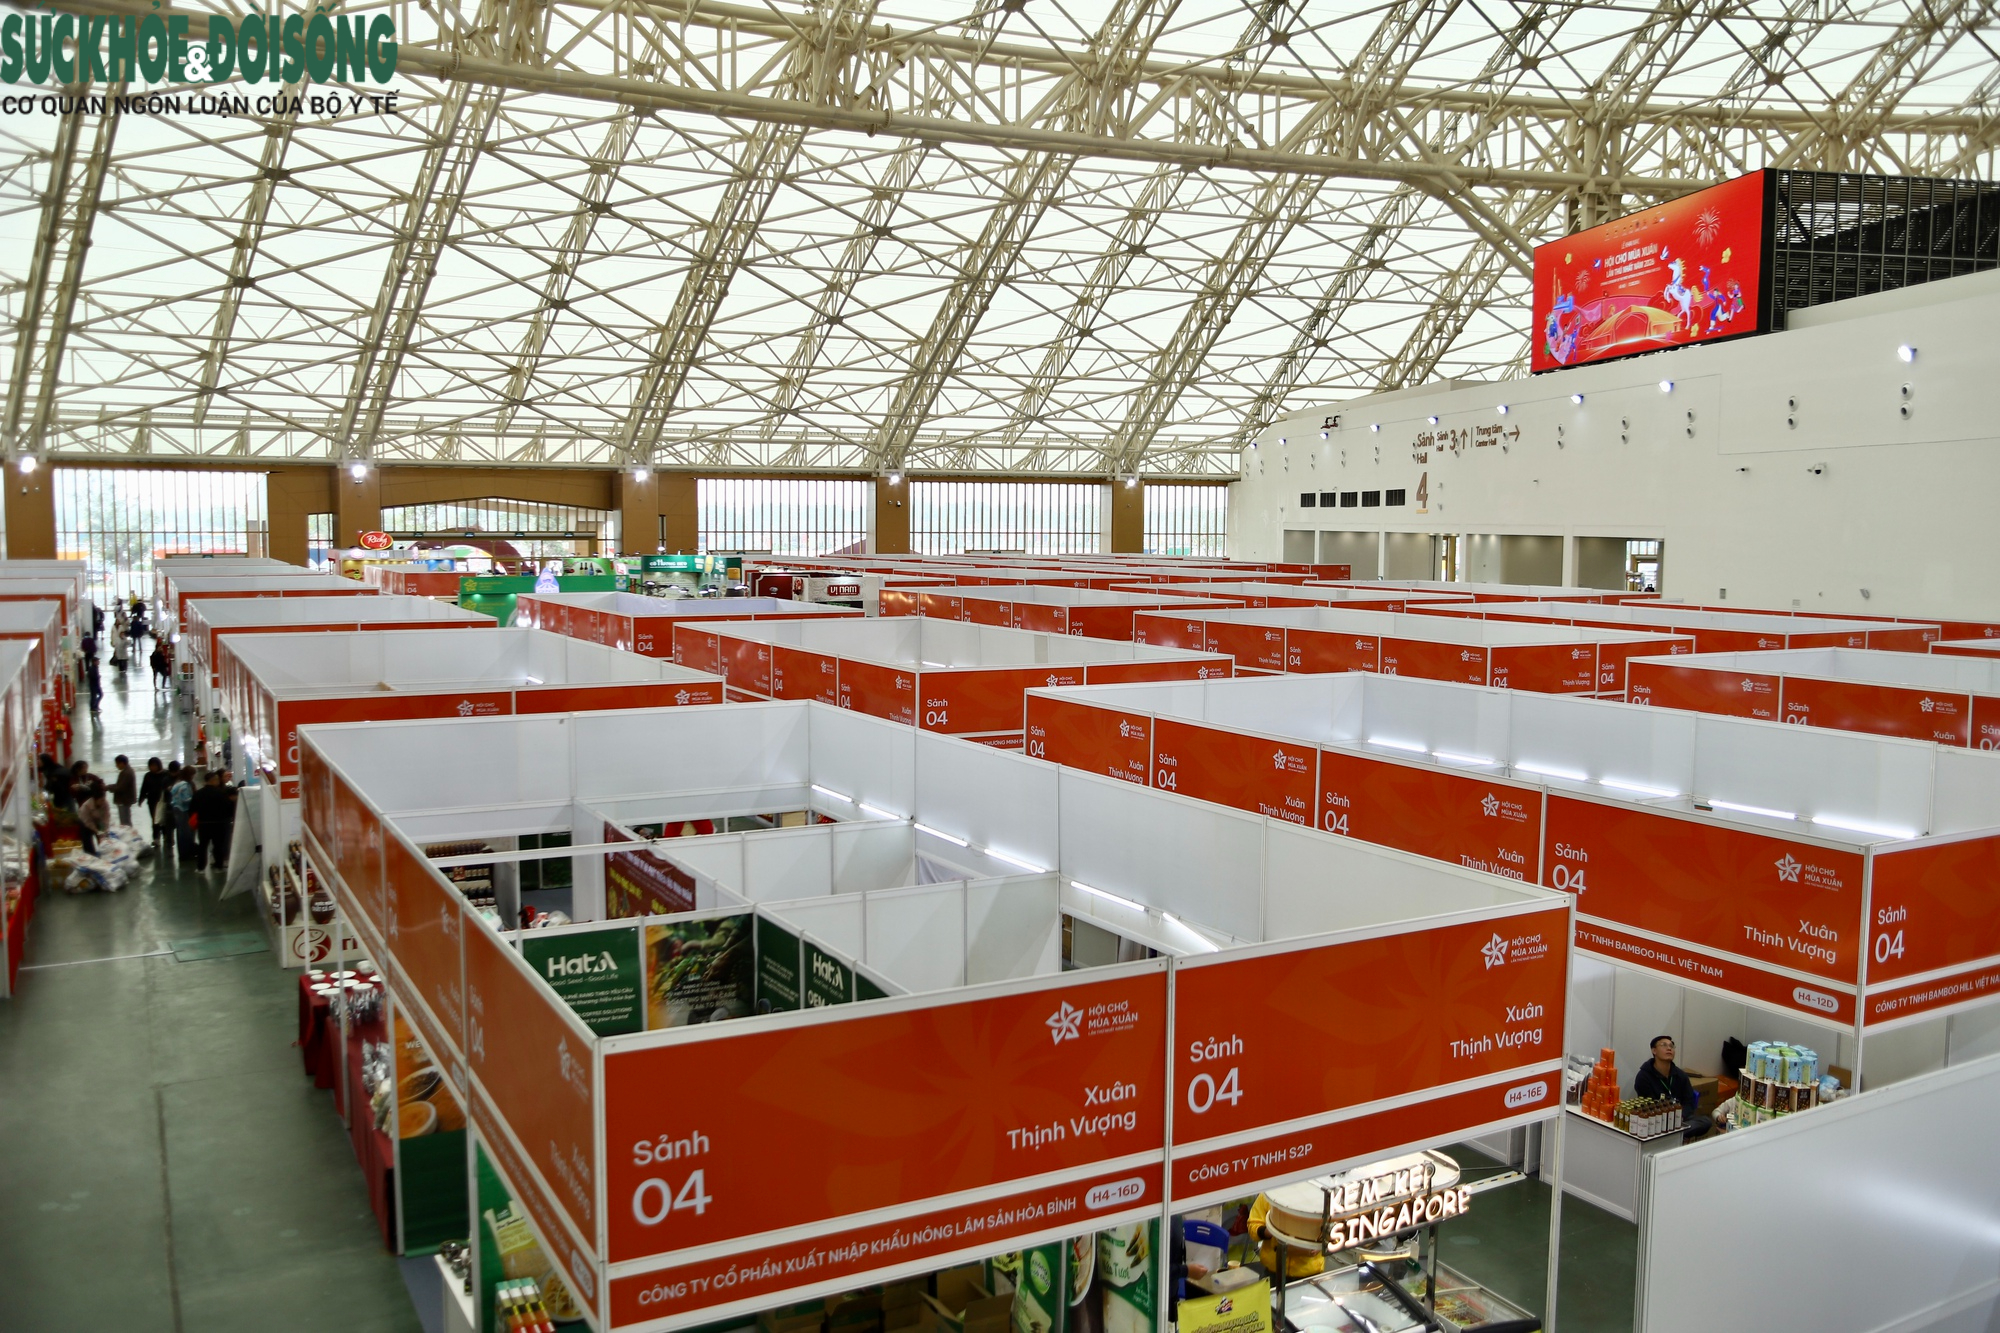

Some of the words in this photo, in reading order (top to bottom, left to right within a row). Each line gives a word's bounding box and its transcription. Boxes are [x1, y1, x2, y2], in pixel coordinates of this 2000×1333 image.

[1604, 255, 1614, 268] HỘI
[1615, 252, 1627, 265] CHỢ
[1628, 248, 1641, 261] MÙA
[1642, 243, 1658, 257] XUÂN
[1436, 431, 1448, 441] Sảnh
[1476, 426, 1491, 437] Trung
[1492, 424, 1502, 434] tâm
[1417, 432, 1434, 447] Sảnh
[1449, 430, 1456, 450] 3
[1488, 438, 1497, 446] Hall
[1416, 452, 1427, 464] Hall
[1416, 471, 1428, 508] 4
[840, 585, 858, 593] NAM
[1072, 628, 1083, 636] 04
[638, 641, 653, 652] 04
[1290, 646, 1301, 654] Sảnh
[1289, 656, 1301, 666] 04
[1384, 656, 1397, 664] Sảnh
[775, 678, 783, 691] 04
[1493, 677, 1507, 688] 04
[1601, 672, 1614, 684] 04
[1633, 684, 1650, 694] Sảnh
[841, 696, 850, 709] 04
[927, 698, 948, 708] Sảnh
[1787, 702, 1809, 713] Sảnh
[926, 711, 948, 725] 04
[1752, 708, 1770, 717] Xuân
[1030, 725, 1045, 738] Sảnh
[1933, 730, 1956, 740] Xuân
[1030, 740, 1045, 758] 04
[1128, 759, 1144, 772] Xuân
[1158, 752, 1178, 767] Sảnh
[1158, 769, 1177, 790] 04
[1285, 795, 1305, 809] Xuân
[1326, 791, 1350, 808] Sảnh
[1324, 810, 1349, 835] 04
[1497, 847, 1524, 865] Xuân
[1554, 842, 1588, 863] Sảnh
[1552, 864, 1587, 895] 04
[1805, 864, 1818, 873] HỘI
[1818, 867, 1835, 878] CHỢ
[1804, 873, 1820, 883] MÙA
[1822, 877, 1843, 887] XUÂN
[1878, 905, 1906, 925] Sảnh
[1799, 918, 1838, 942] Xuân
[1511, 936, 1524, 946] HỘI
[1525, 933, 1541, 944] CHỢ
[1744, 924, 1784, 949] Thịnh
[1786, 938, 1837, 965] Vượng
[1875, 929, 1905, 963] 04
[1511, 947, 1527, 957] MÙA
[1528, 943, 1548, 954] XUÂN
[1578, 931, 1590, 940] TY
[1590, 933, 1614, 948] TNHH
[1615, 941, 1655, 958] BAMBOO
[1656, 952, 1676, 966] HILL
[1678, 957, 1699, 972] VIỆT
[1700, 963, 1723, 978] NAM
[1798, 990, 1835, 1009] H4-12D
[1875, 999, 1897, 1013] CÔNG
[1898, 996, 1908, 1008] TY
[1909, 992, 1928, 1005] TNHH
[1929, 984, 1958, 1000] BAMBOO
[1960, 981, 1974, 992] HILL
[1975, 975, 1989, 990] VIỆT
[1088, 1003, 1105, 1016] HỘI
[1107, 1000, 1128, 1013] CHỢ
[1505, 1001, 1544, 1023] Xuân
[1088, 1015, 1109, 1029] MÙA
[1112, 1011, 1138, 1025] XUÂN
[1190, 1034, 1244, 1063] Sảnh
[1450, 1036, 1492, 1060] Thịnh
[1494, 1026, 1543, 1050] Vượng
[1085, 1080, 1137, 1107] Xuân
[1187, 1066, 1244, 1114] 04
[1508, 1085, 1543, 1105] H4-16E
[1006, 1122, 1066, 1151] Thịnh
[1071, 1109, 1137, 1138] Vượng
[633, 1129, 710, 1166] Sảnh
[1189, 1162, 1229, 1182] CÔNG
[1232, 1158, 1249, 1172] TY
[1252, 1149, 1286, 1168] TNHH
[1289, 1143, 1313, 1160] S2P
[632, 1168, 713, 1226] 04
[1093, 1183, 1140, 1204] H4-16D
[1330, 1180, 1381, 1216] KEM
[1327, 1188, 1471, 1252] SINGAPORE
[638, 1281, 687, 1306] CÔNG
[690, 1277, 710, 1294] TY
[713, 1264, 737, 1290] CỔ
[740, 1257, 782, 1281] PHẦN
[785, 1247, 826, 1274] XUẤT
[829, 1240, 868, 1264] NHẬP
[871, 1227, 909, 1254] KHẨU
[912, 1223, 953, 1244] NÔNG
[956, 1216, 984, 1236] LÂM
[987, 1206, 1014, 1228] SẢN
[1016, 1202, 1044, 1222] HÒA
[1047, 1196, 1076, 1215] BÌNH
